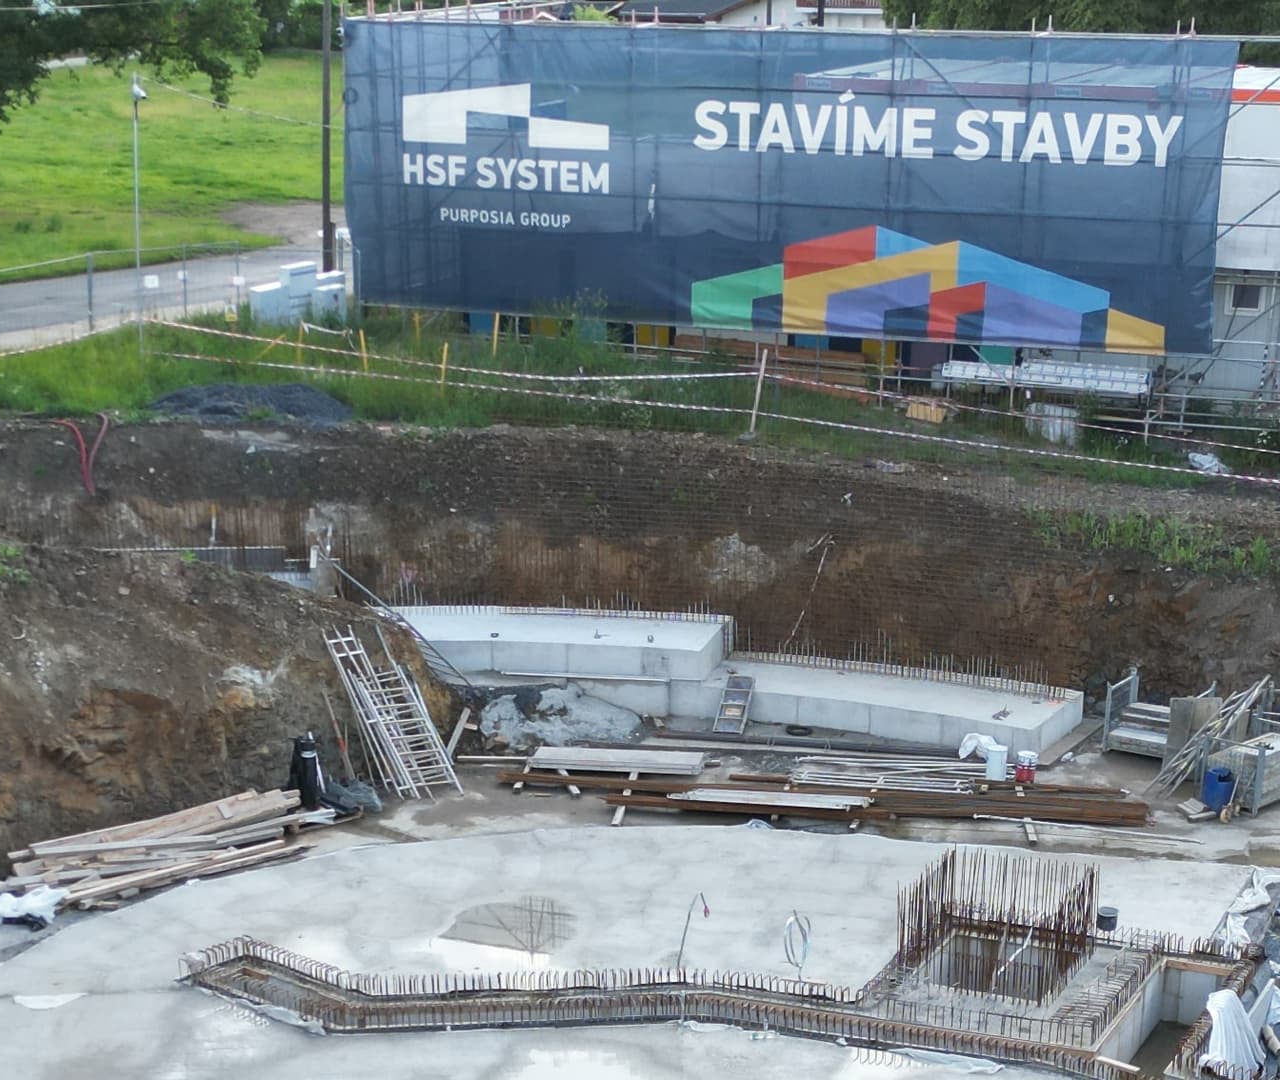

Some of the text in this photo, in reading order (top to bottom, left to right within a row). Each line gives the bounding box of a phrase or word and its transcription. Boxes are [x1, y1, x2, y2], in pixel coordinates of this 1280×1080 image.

[693, 89, 1185, 168] STAVÍME STAVBY
[402, 153, 610, 194] HSF SYSTEM
[439, 207, 571, 229] PURPOSIA GROUP
